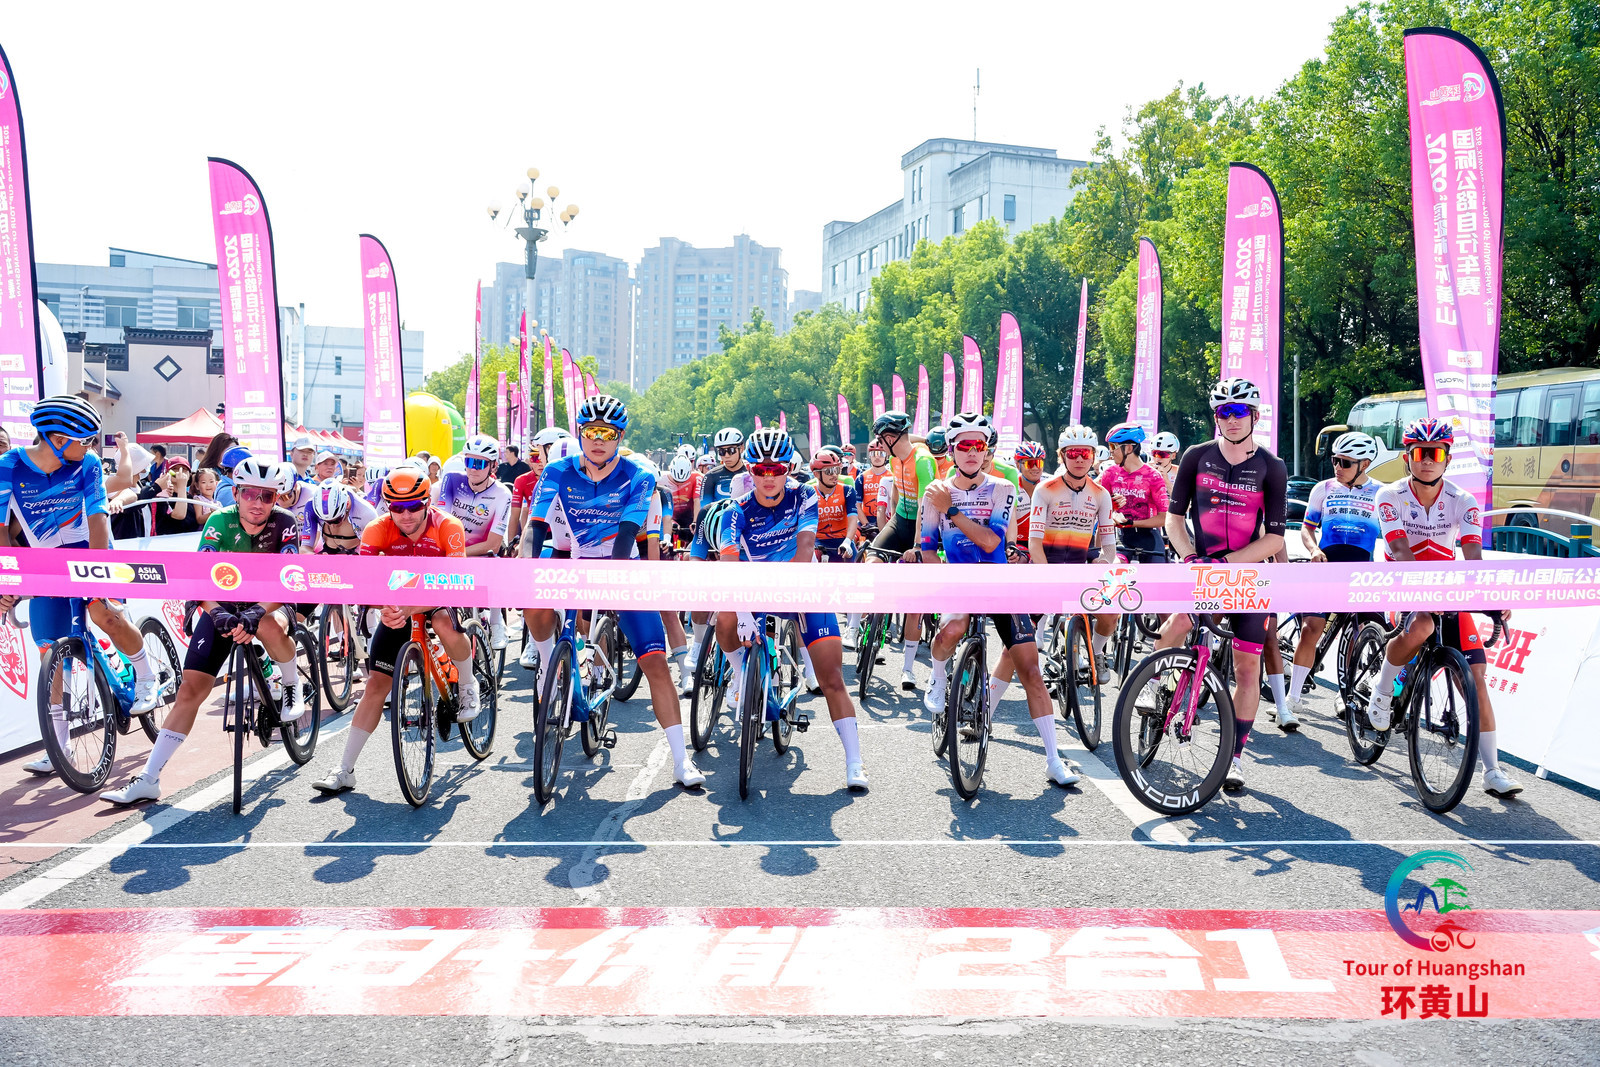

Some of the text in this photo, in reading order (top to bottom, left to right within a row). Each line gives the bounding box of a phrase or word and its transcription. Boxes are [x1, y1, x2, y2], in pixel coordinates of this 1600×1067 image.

[1202, 477, 1213, 485] ST
[1218, 482, 1257, 493] GEORGE
[1335, 493, 1374, 503] WHEELTOP
[817, 506, 844, 515] OOJAI
[1002, 494, 1014, 521] DYC
[1328, 508, 1373, 520] 成都高新
[1402, 520, 1452, 531] Tianyoude Hotel
[1406, 529, 1431, 538] Cycling
[73, 564, 111, 579] UCI
[138, 567, 158, 575] ASIA
[1190, 565, 1271, 587] TOUR OF
[138, 573, 163, 582] TOUR
[308, 573, 341, 583] 环黄山
[424, 573, 475, 585] 奥众体育
[711, 590, 731, 603] OF
[735, 591, 822, 604] HUANGSHAN
[1192, 588, 1256, 599] HUANG
[1523, 589, 1543, 601] OF
[1194, 598, 1271, 610] 2026 SHAN
[159, 628, 183, 684] K-POWE
[1484, 673, 1519, 694] 动营养
[90, 712, 116, 784] K-POWER
[916, 926, 1335, 992] 2合1
